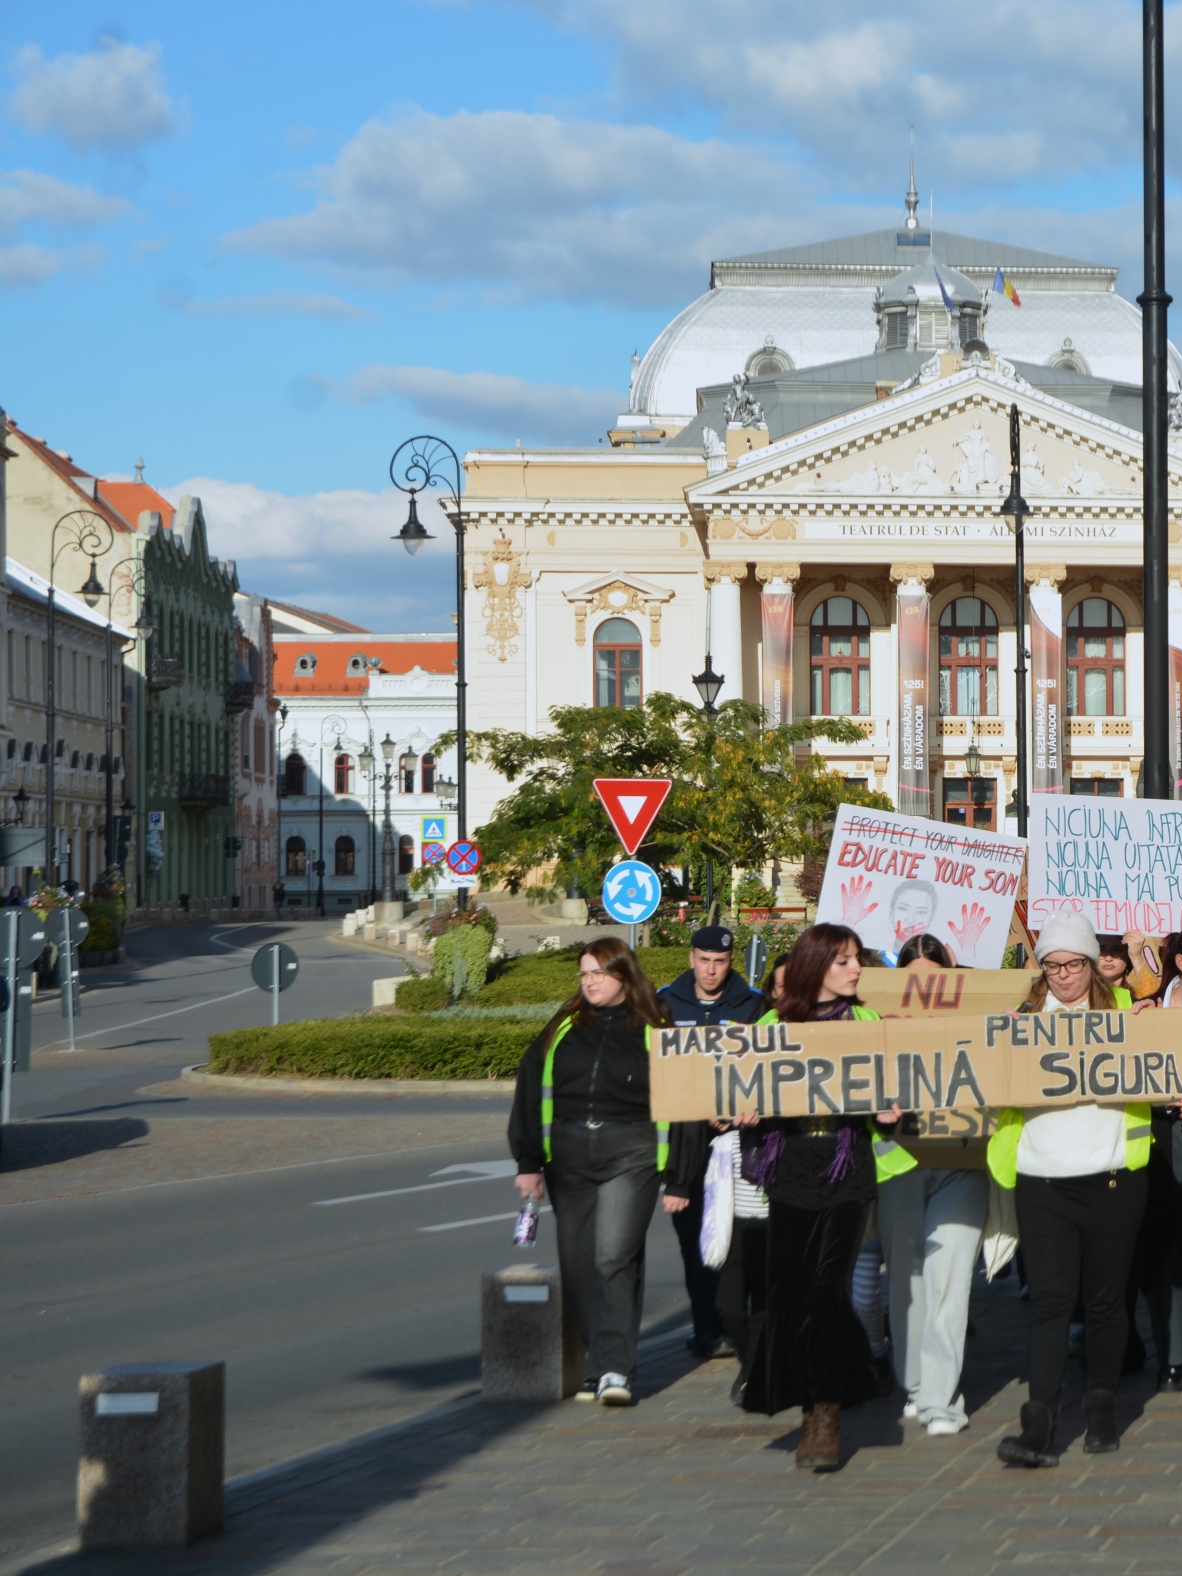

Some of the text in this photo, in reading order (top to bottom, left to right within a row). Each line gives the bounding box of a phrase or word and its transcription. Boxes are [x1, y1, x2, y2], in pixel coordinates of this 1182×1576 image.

[839, 522, 1118, 538] TEATRUL DE STAT ÁLLMI SZÍNHÁZ
[913, 705, 924, 770] ÉN VÁRADOM
[1047, 704, 1057, 769] ÉN VÁRADOM
[902, 757, 912, 770] ÉN
[1036, 756, 1046, 769] ÉN
[849, 815, 1025, 865] PROTECT YOUR DAUGHTER
[1045, 805, 1133, 841] NICIUNA
[837, 840, 925, 880] EDUCATE
[934, 855, 976, 889] YOUR
[978, 868, 1019, 896] SON
[1046, 839, 1112, 870] NICIUNA
[1046, 868, 1112, 899] NICIUNA
[1125, 872, 1155, 903] MAI
[900, 972, 966, 1010] NU
[985, 1011, 1126, 1048] PENTRU
